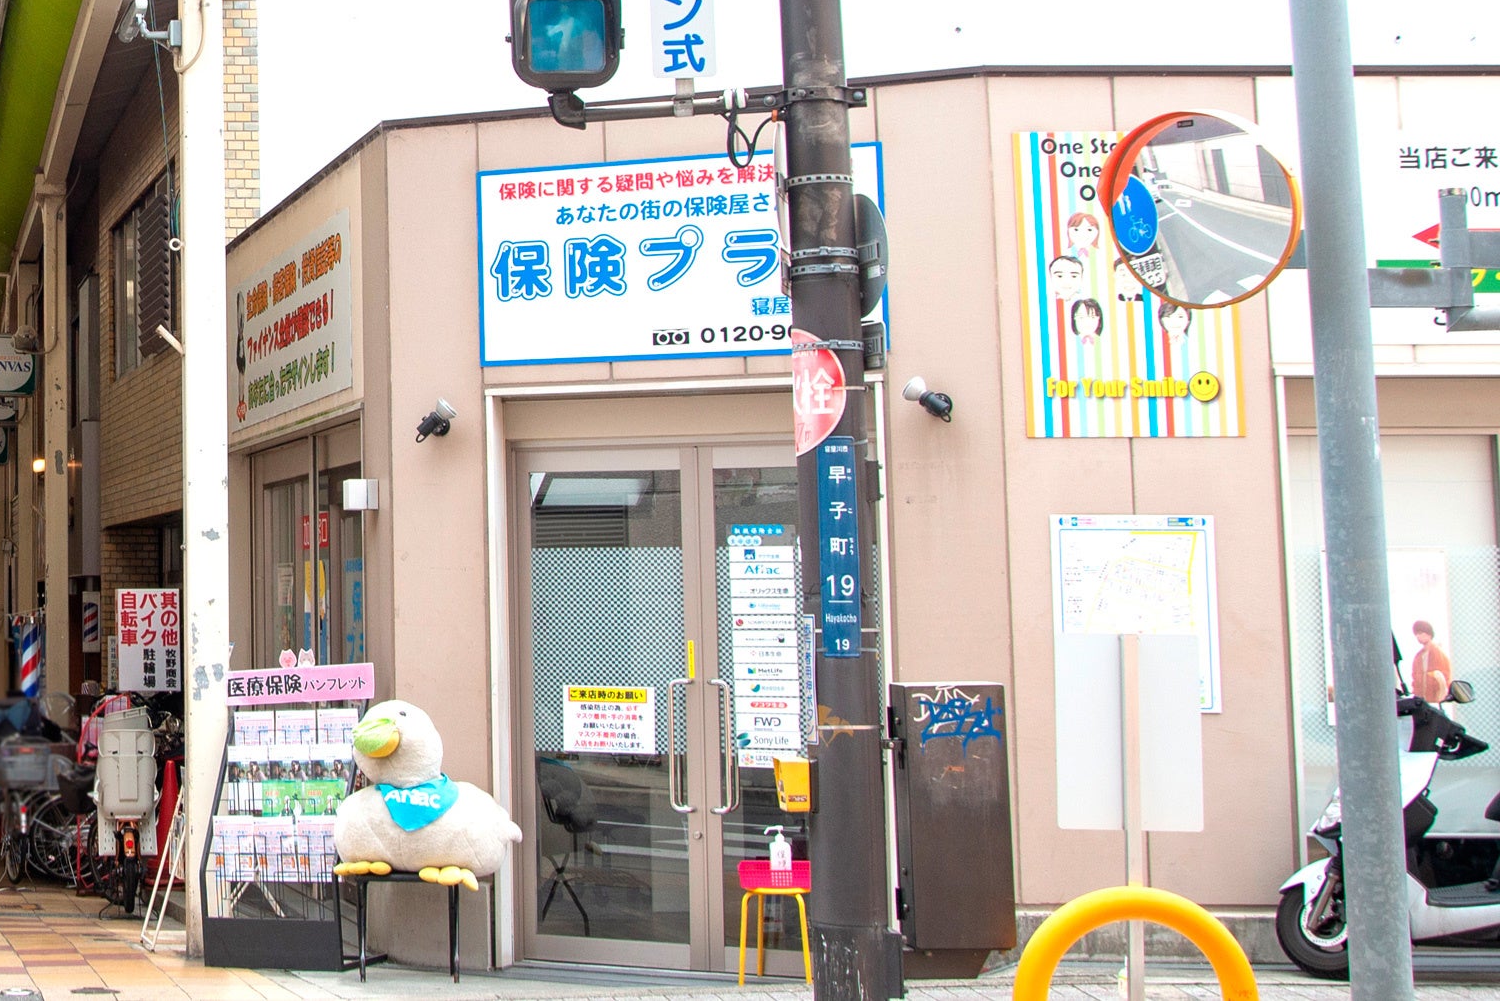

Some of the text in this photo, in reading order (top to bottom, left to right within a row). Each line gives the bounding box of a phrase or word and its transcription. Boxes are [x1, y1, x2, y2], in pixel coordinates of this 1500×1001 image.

[1041, 138, 1083, 155] One
[1399, 146, 1499, 169] 当店ご来
[1060, 161, 1101, 178] One
[499, 163, 774, 201] 保険に関する疑問や悩みを解決
[556, 192, 777, 226] あなたの街の保険屋さ
[1046, 377, 1189, 398] For Your Smile
[828, 465, 849, 556] 早子町
[826, 574, 855, 597] 19
[120, 591, 139, 647] 自転車
[139, 593, 158, 688] バイク 駐輪場
[160, 591, 179, 688] 其の他 牧野商会
[835, 638, 850, 651] 19
[569, 689, 643, 700] ご来店時のお願い
[754, 716, 781, 727] FWD
[754, 736, 789, 745] Sony Life
